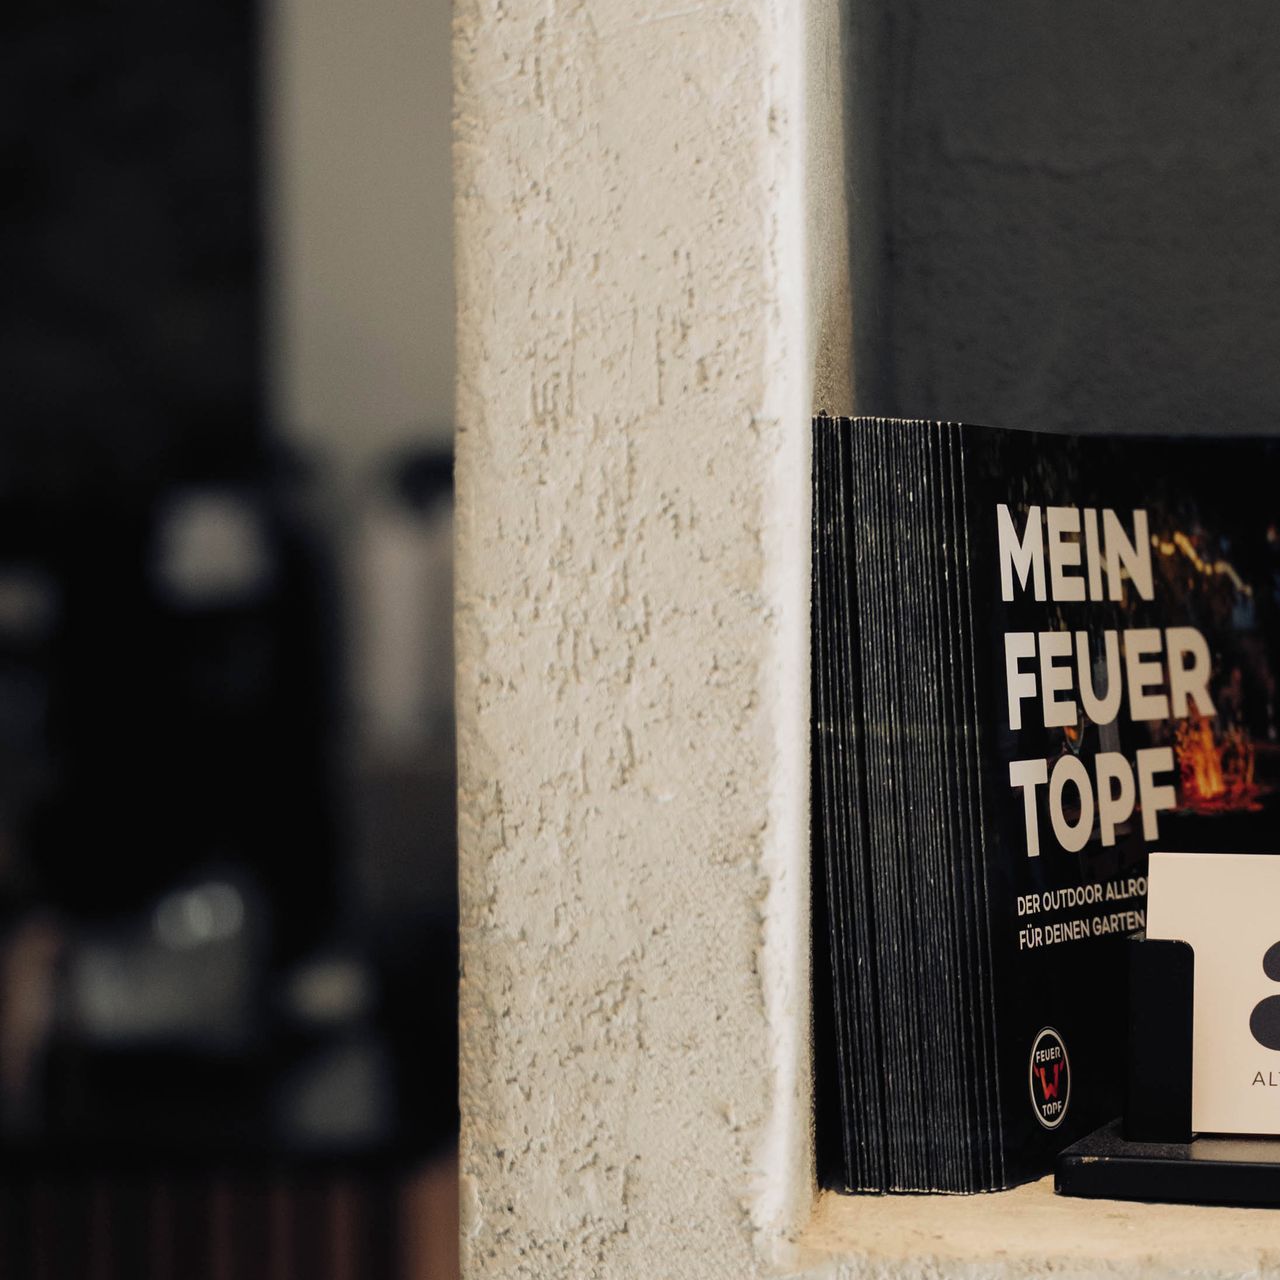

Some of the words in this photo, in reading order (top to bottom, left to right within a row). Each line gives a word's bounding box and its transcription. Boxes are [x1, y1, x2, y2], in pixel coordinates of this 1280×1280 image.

[997, 504, 1154, 601] MEIN
[1004, 627, 1216, 730] FEUER
[1009, 747, 1177, 857] TOPF
[1017, 893, 1041, 916] DER
[1042, 884, 1103, 911] OUTDOOR
[1105, 877, 1148, 901] ALLRO
[1019, 924, 1043, 950] FÜR
[1045, 918, 1091, 945] DEINEN
[1092, 909, 1146, 936] GARTEN
[1036, 1046, 1061, 1063] FEUER
[1042, 1101, 1062, 1116] TOPF
